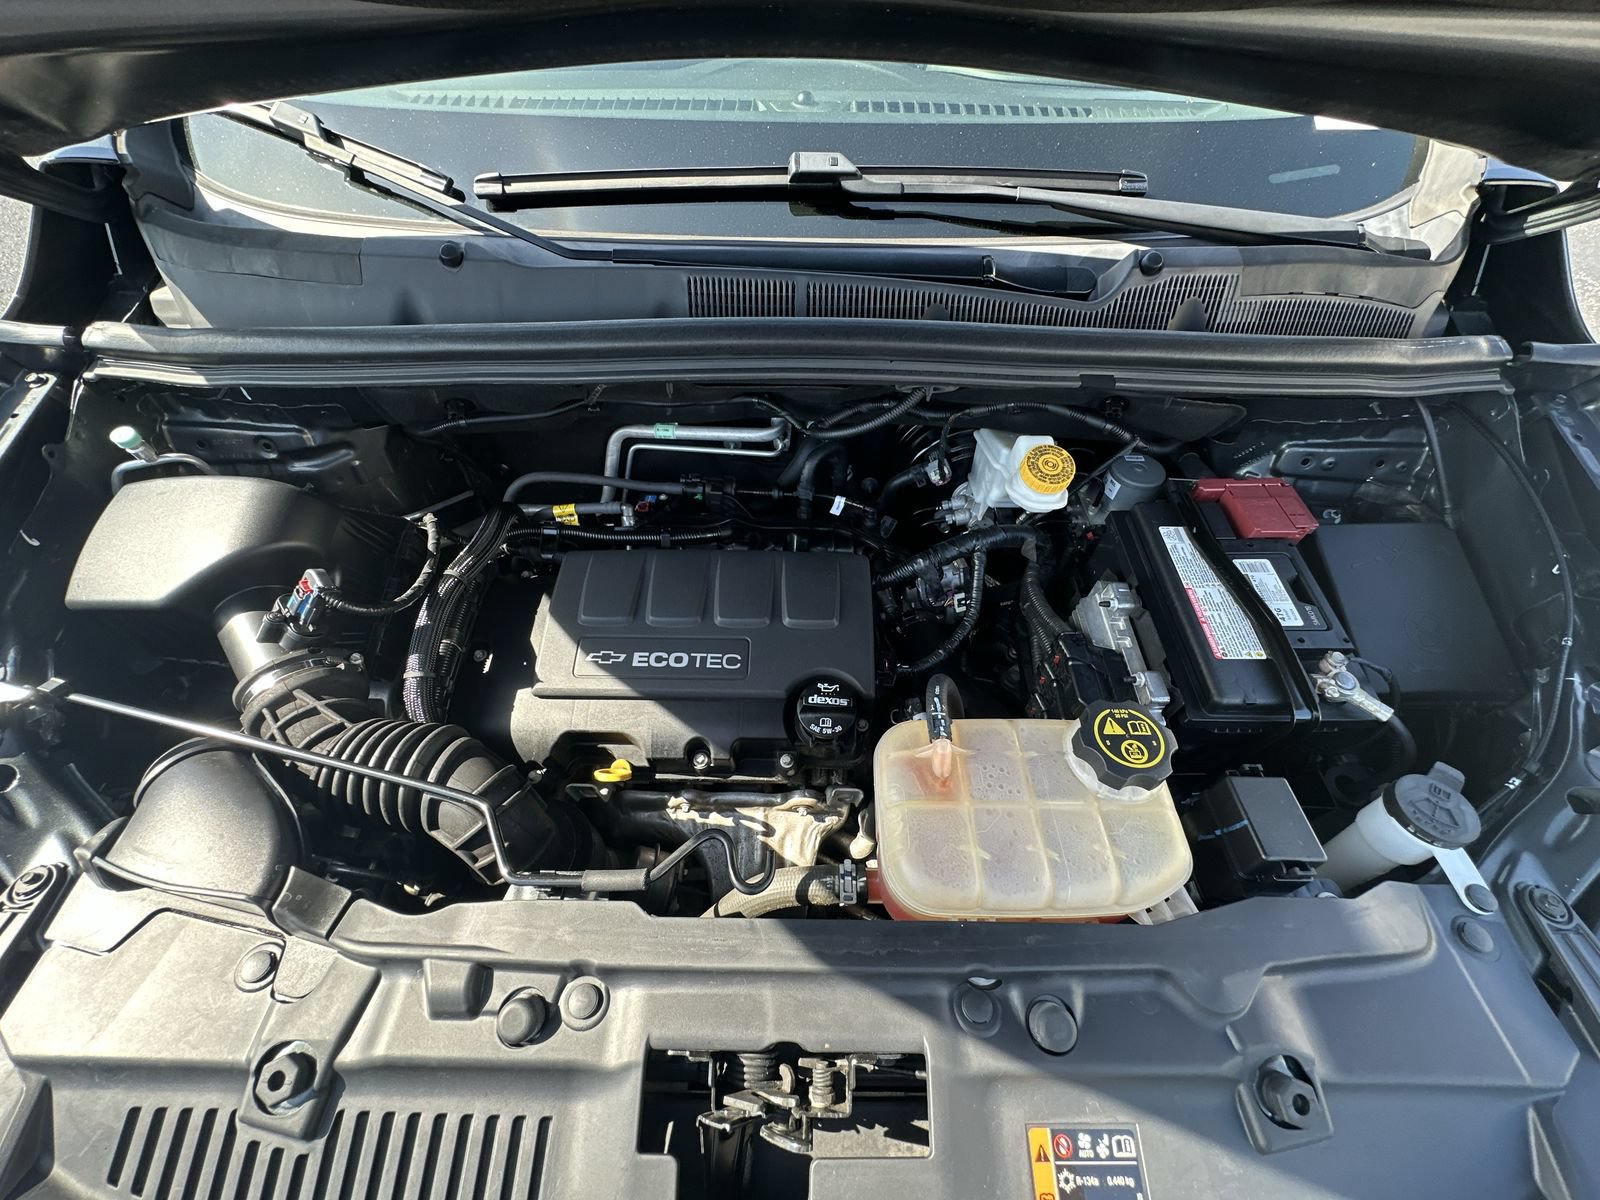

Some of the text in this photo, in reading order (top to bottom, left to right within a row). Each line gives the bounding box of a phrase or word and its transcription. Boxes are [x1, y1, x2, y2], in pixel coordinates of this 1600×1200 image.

[631, 651, 742, 669] ECOTEC
[808, 694, 850, 706] dexos
[810, 723, 843, 734] SAE 5W-30
